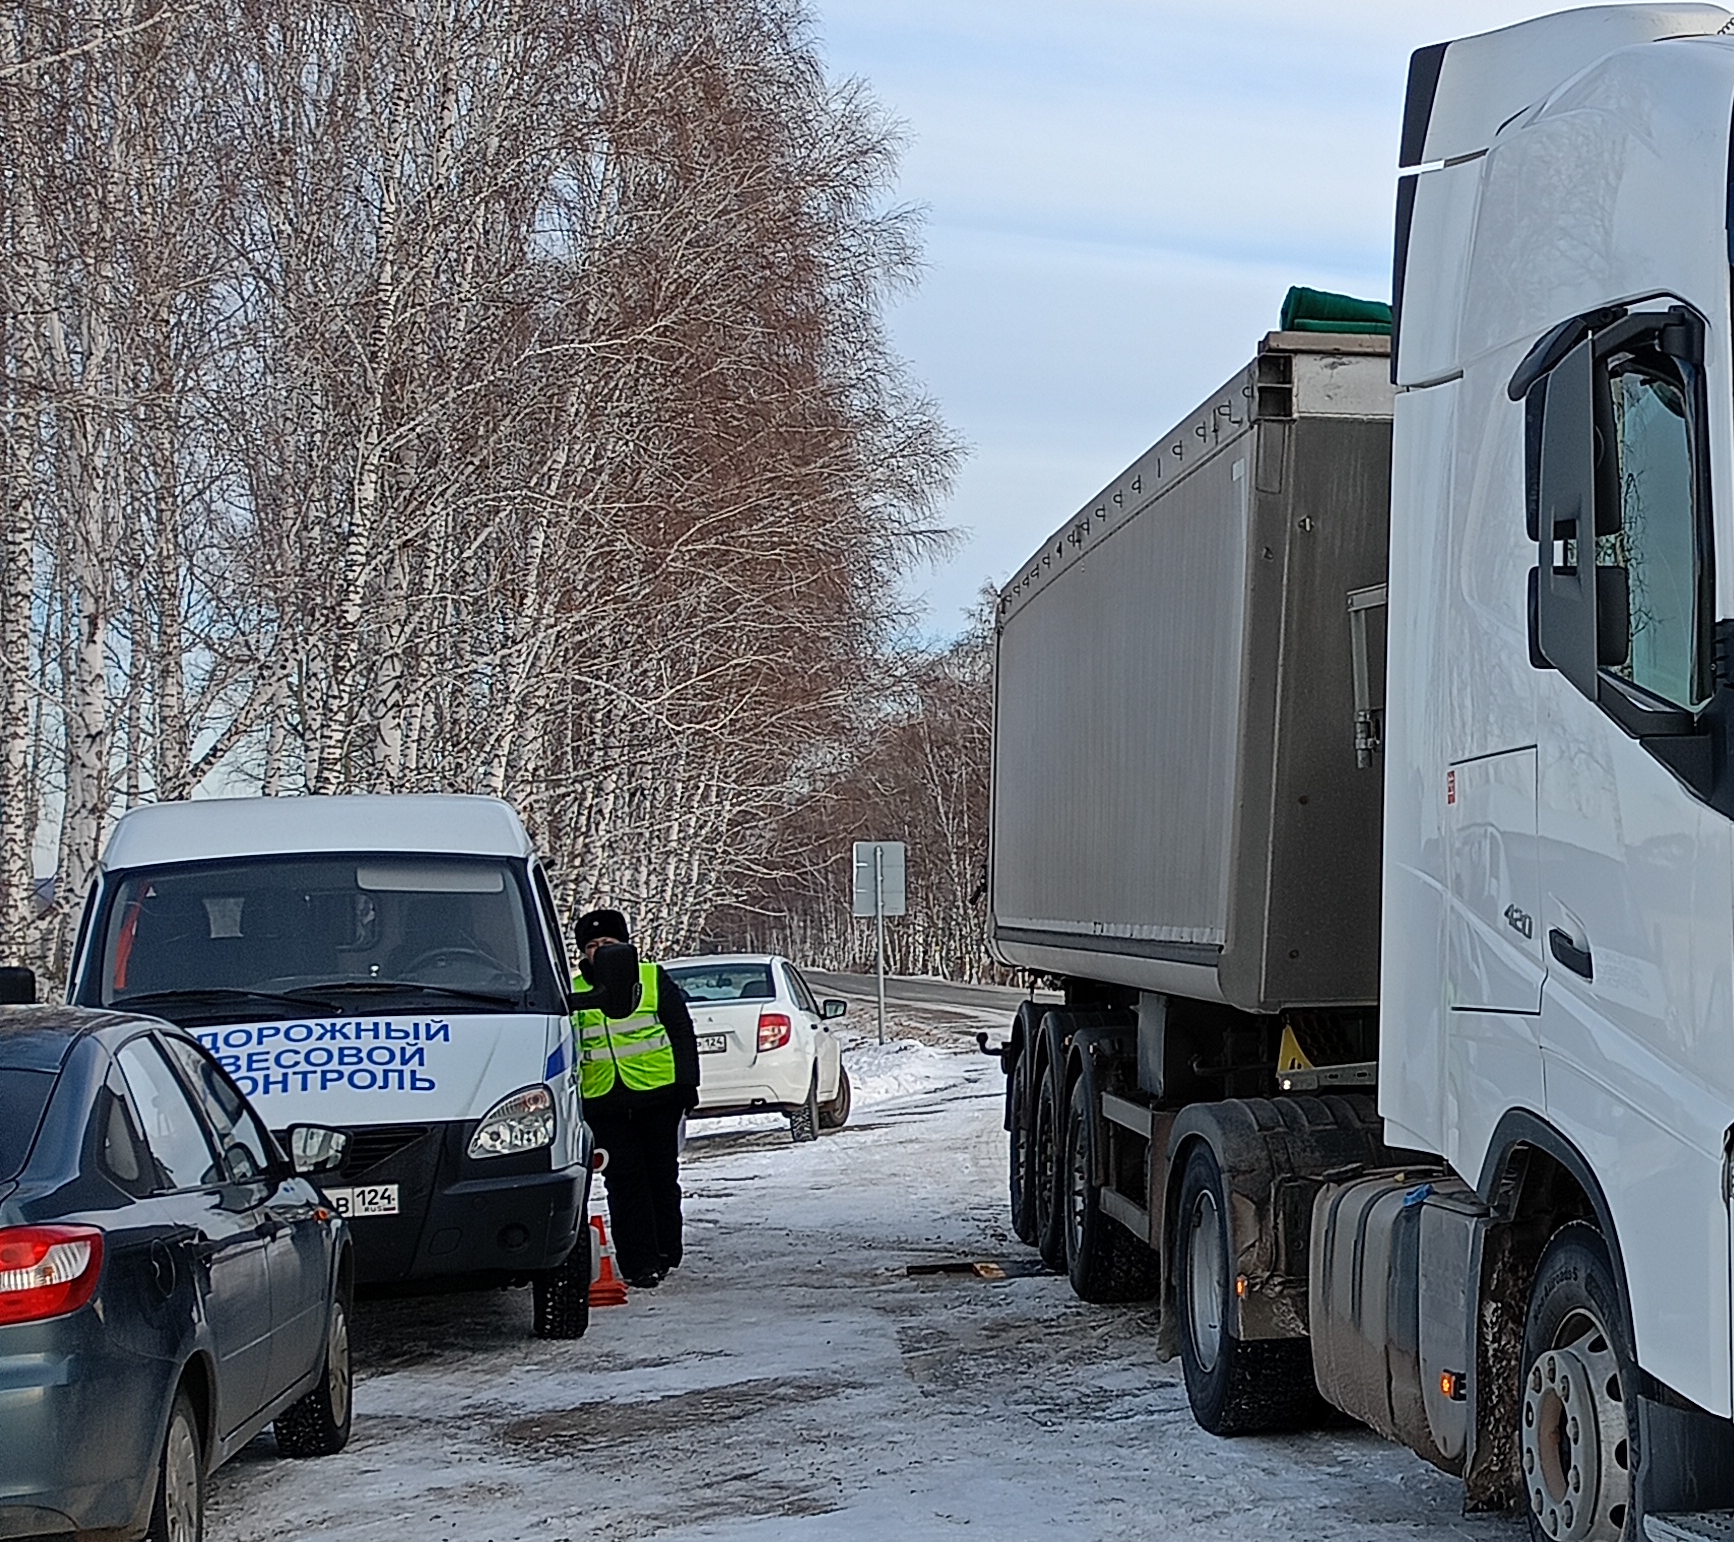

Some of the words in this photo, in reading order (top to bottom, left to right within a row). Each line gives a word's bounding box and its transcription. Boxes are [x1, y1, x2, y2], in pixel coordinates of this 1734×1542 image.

[197, 1018, 450, 1054] ДОРОЖНЫЙ
[232, 1068, 436, 1098] ОНТРОЛЬ
[355, 1187, 392, 1207] 124
